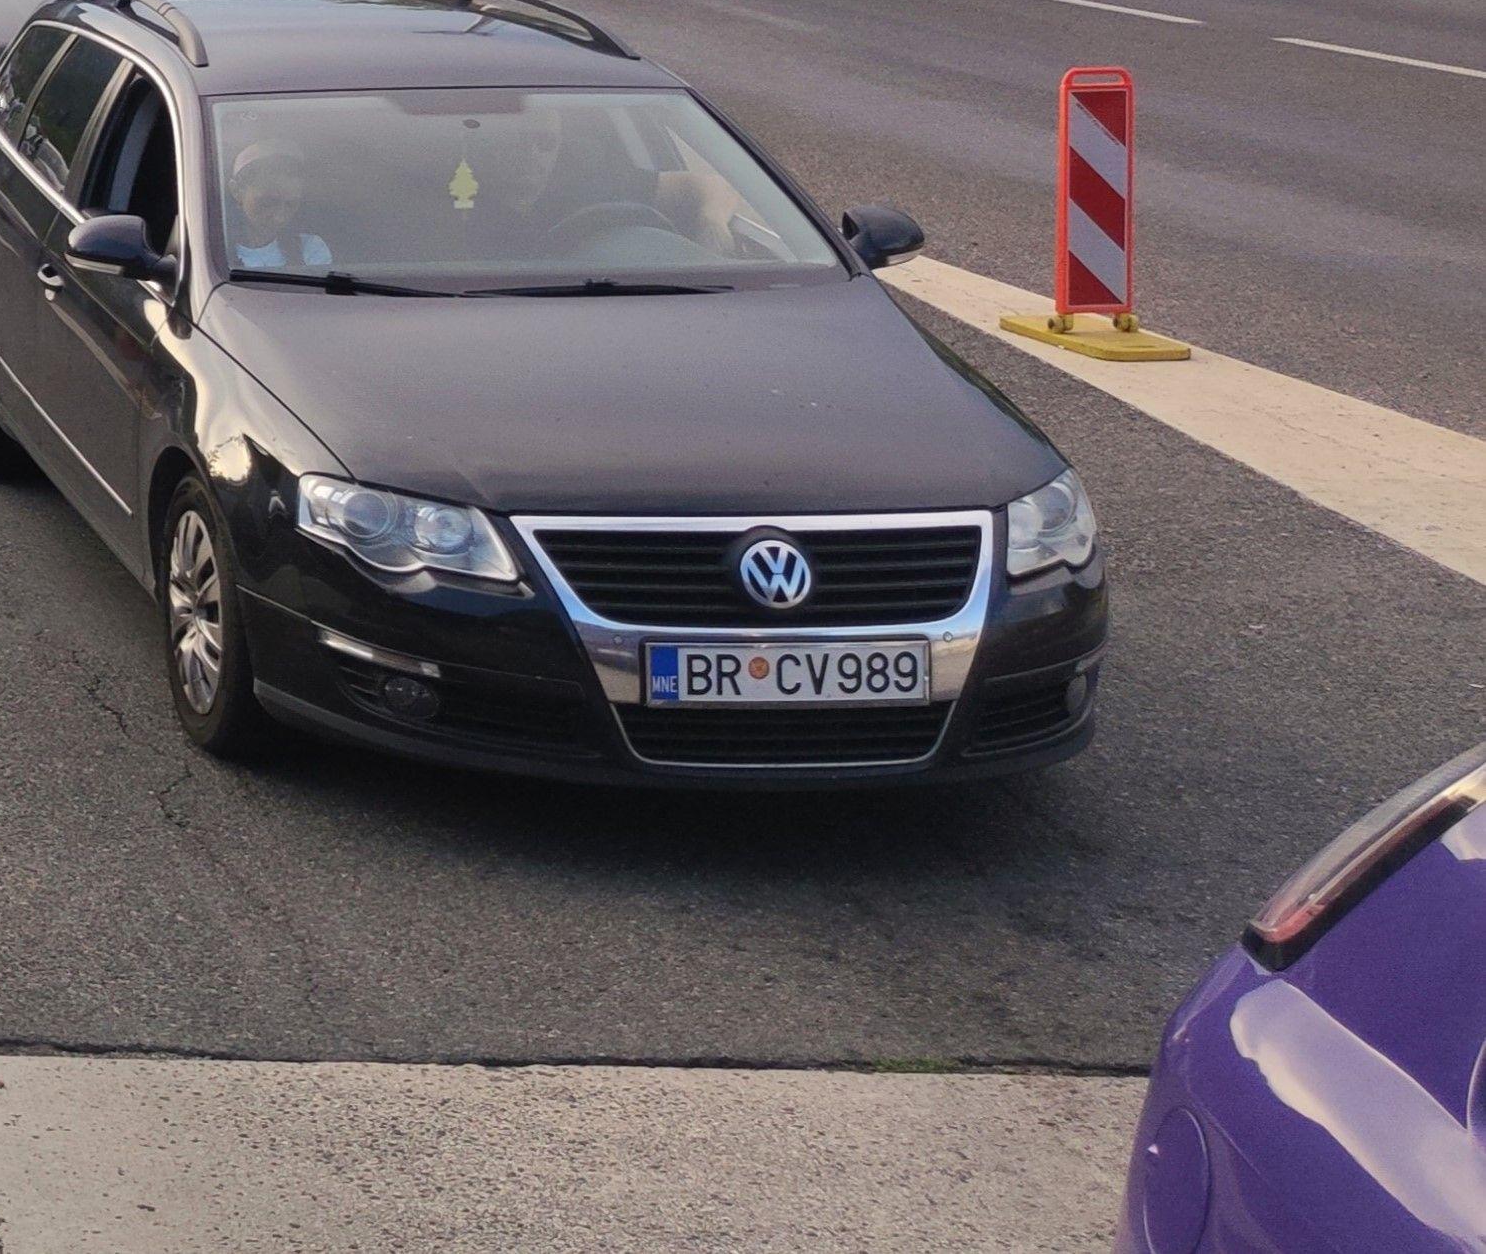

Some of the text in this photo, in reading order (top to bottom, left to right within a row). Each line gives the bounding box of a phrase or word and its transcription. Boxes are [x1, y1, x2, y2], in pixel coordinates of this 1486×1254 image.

[651, 650, 919, 696] MNE BR CV989
